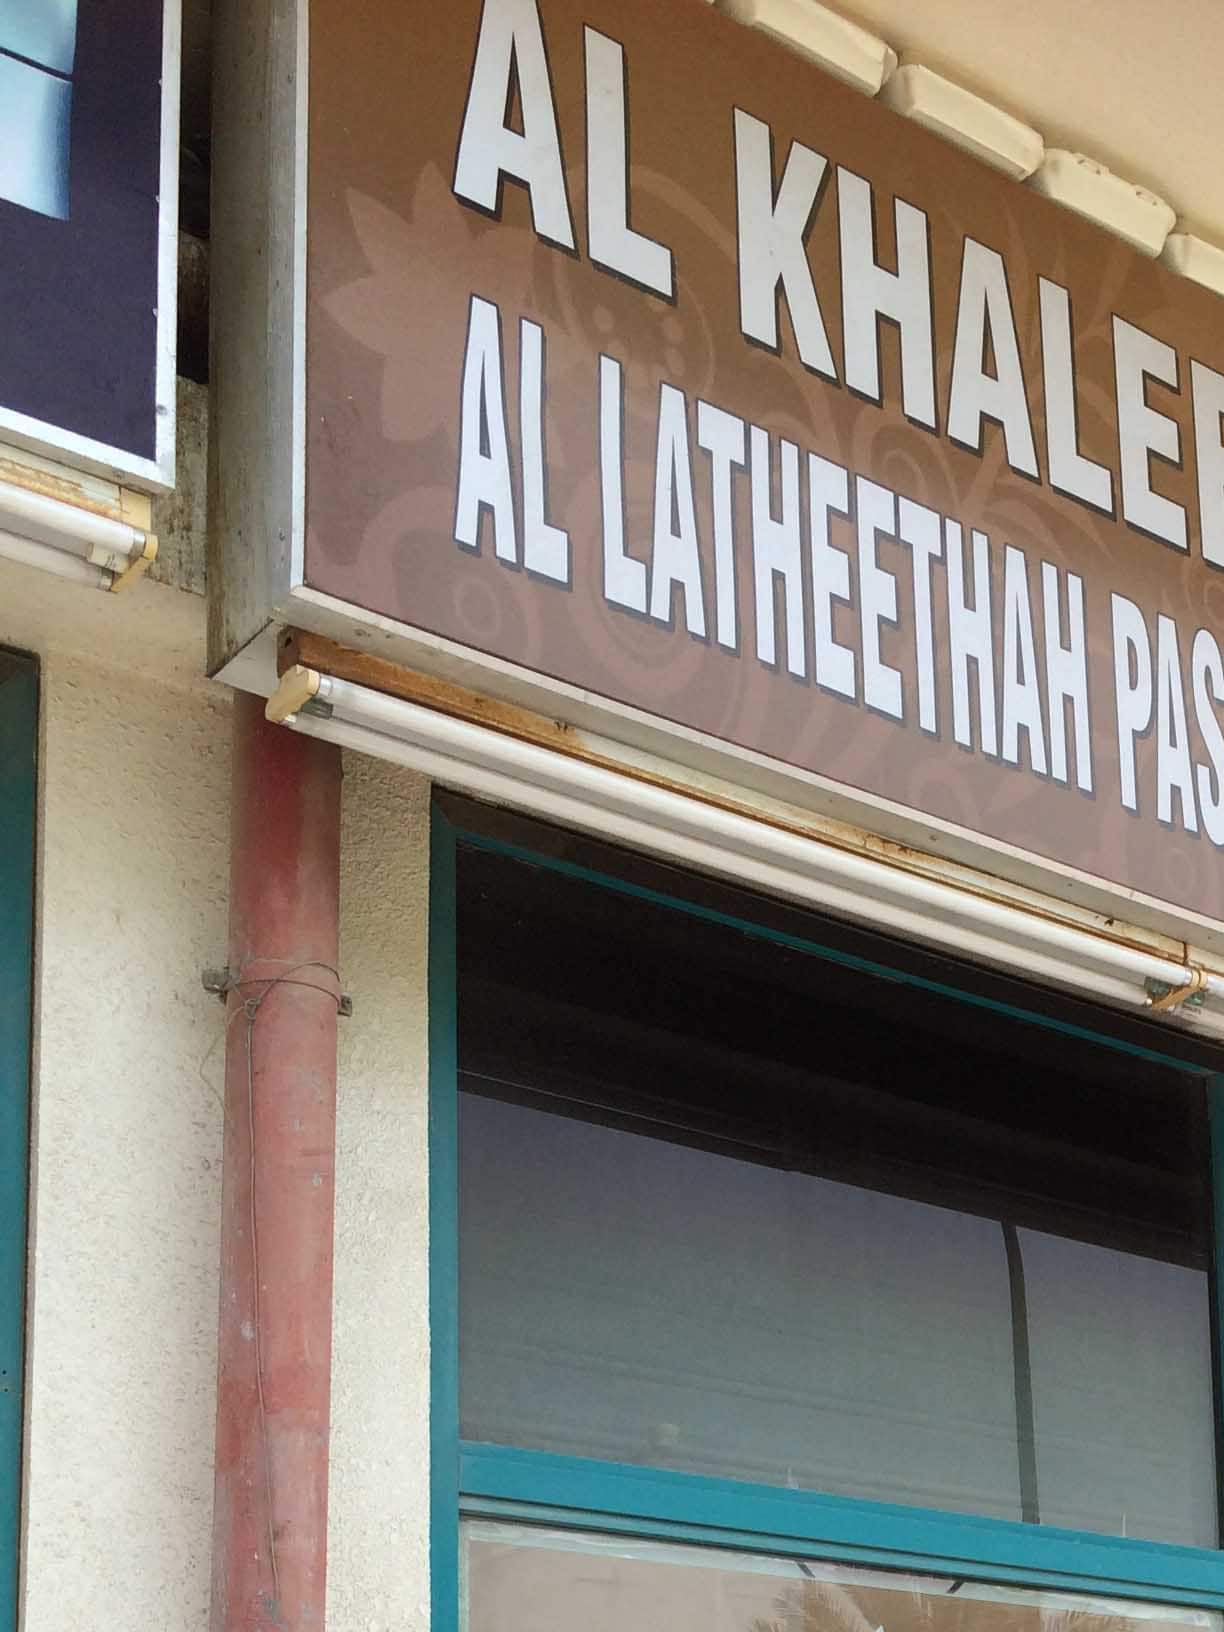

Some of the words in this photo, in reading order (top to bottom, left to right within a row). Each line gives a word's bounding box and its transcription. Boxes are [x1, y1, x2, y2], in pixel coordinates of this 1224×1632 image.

[453, 0, 676, 302] AL
[453, 293, 571, 586] AL
[599, 353, 1095, 796] LATHEETHAH
